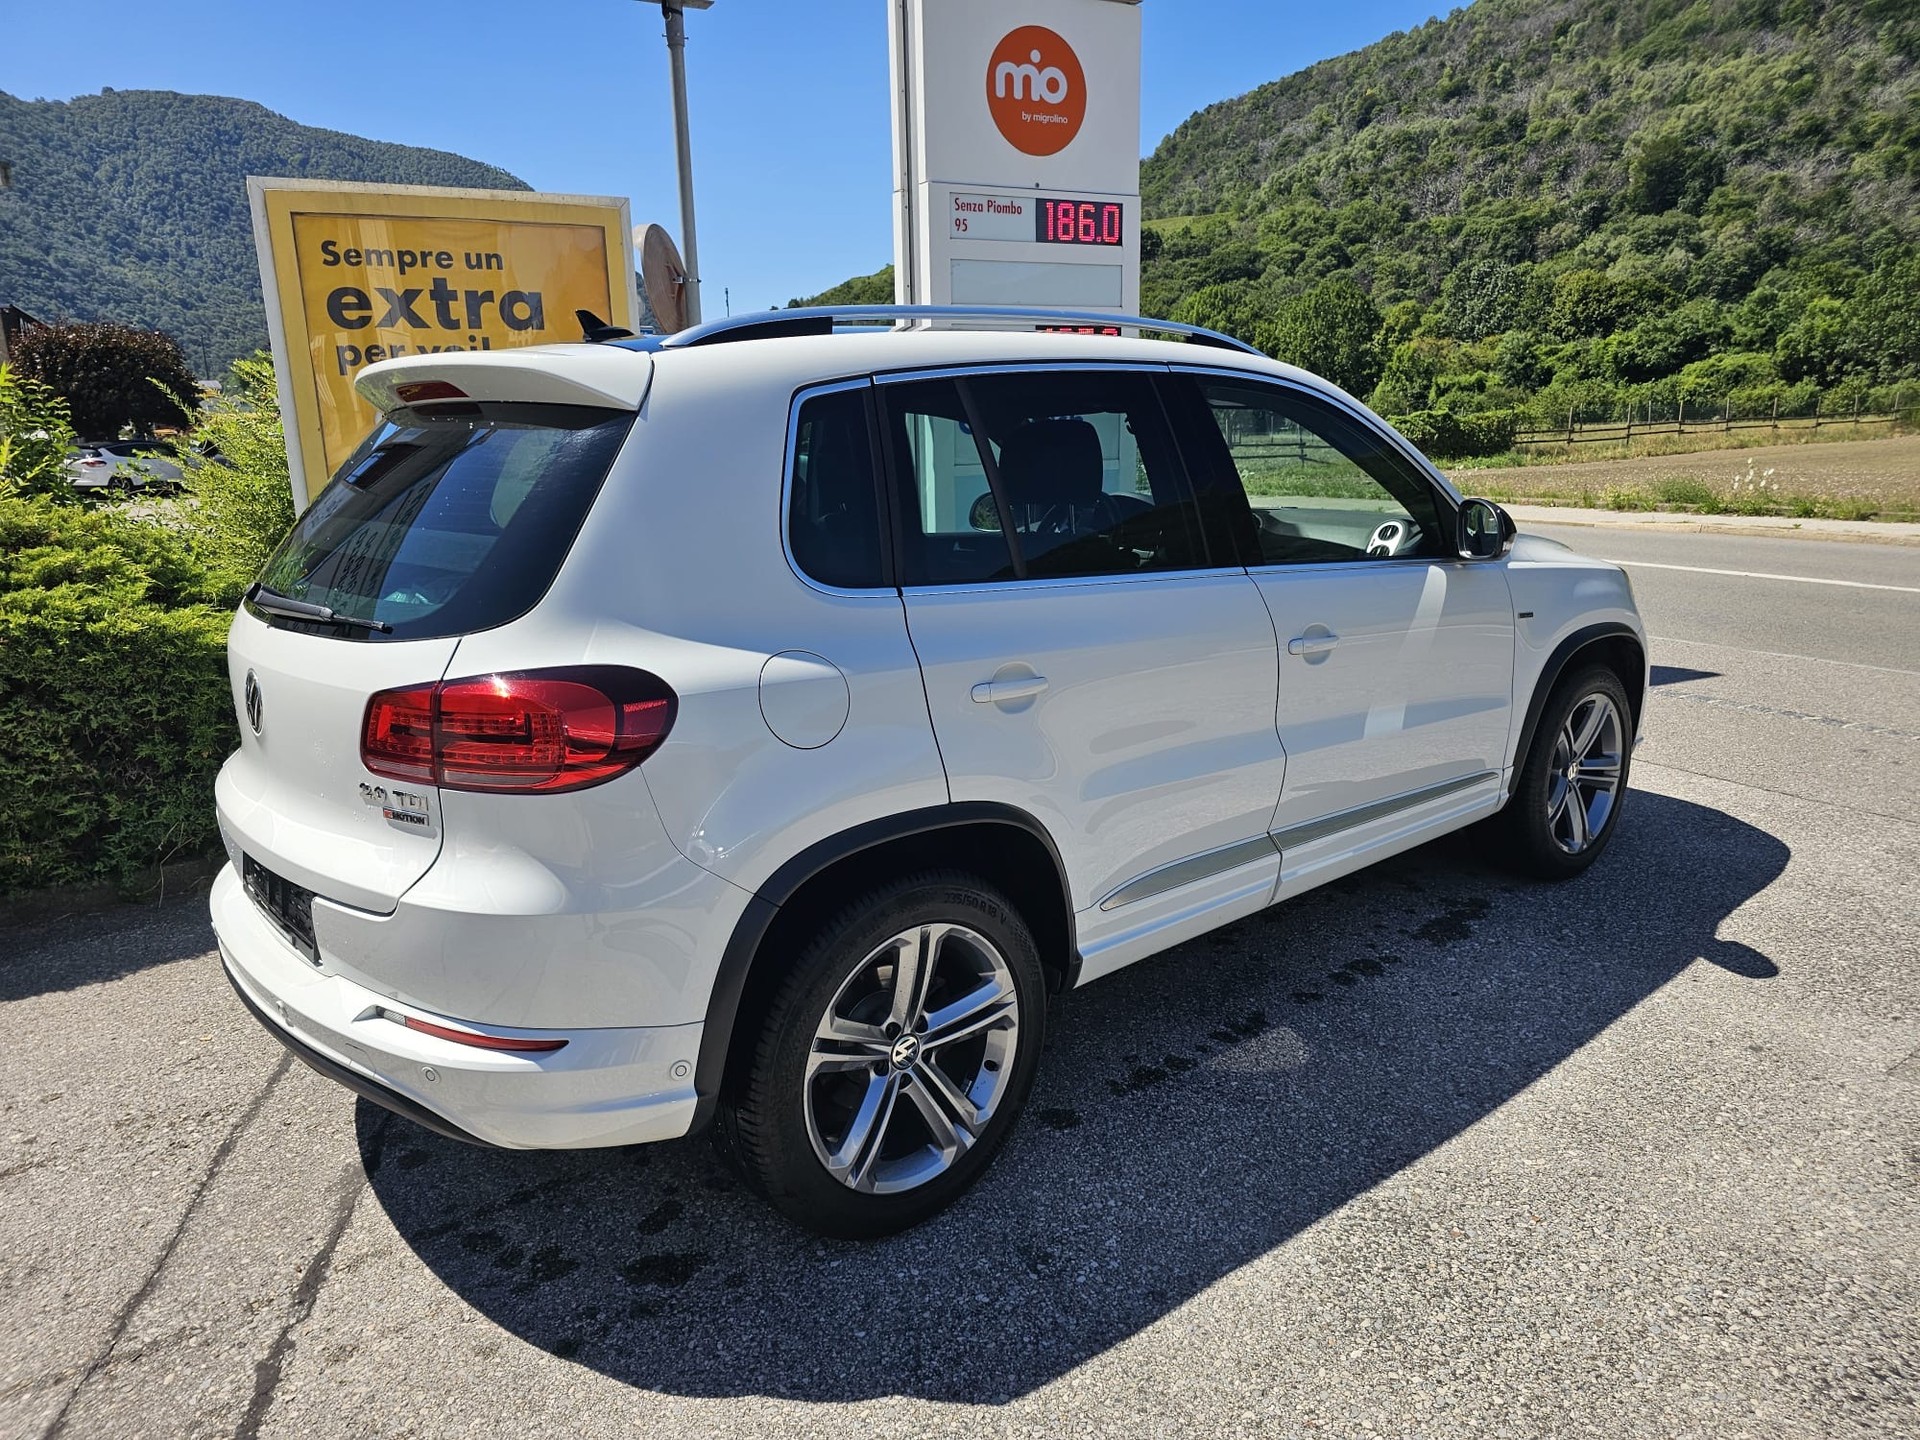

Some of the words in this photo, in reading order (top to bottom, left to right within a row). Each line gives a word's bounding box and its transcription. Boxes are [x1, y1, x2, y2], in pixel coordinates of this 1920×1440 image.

[995, 49, 1068, 105] mio
[1021, 111, 1032, 122] by
[1033, 112, 1068, 124] migrolino
[954, 197, 984, 213] Senza
[987, 199, 1023, 215] Piombo
[954, 218, 968, 232] 95
[1046, 201, 1120, 243] 186.0
[320, 240, 454, 275] Sempre
[464, 251, 504, 271] un
[326, 277, 545, 331] extra
[392, 789, 429, 812] TDI
